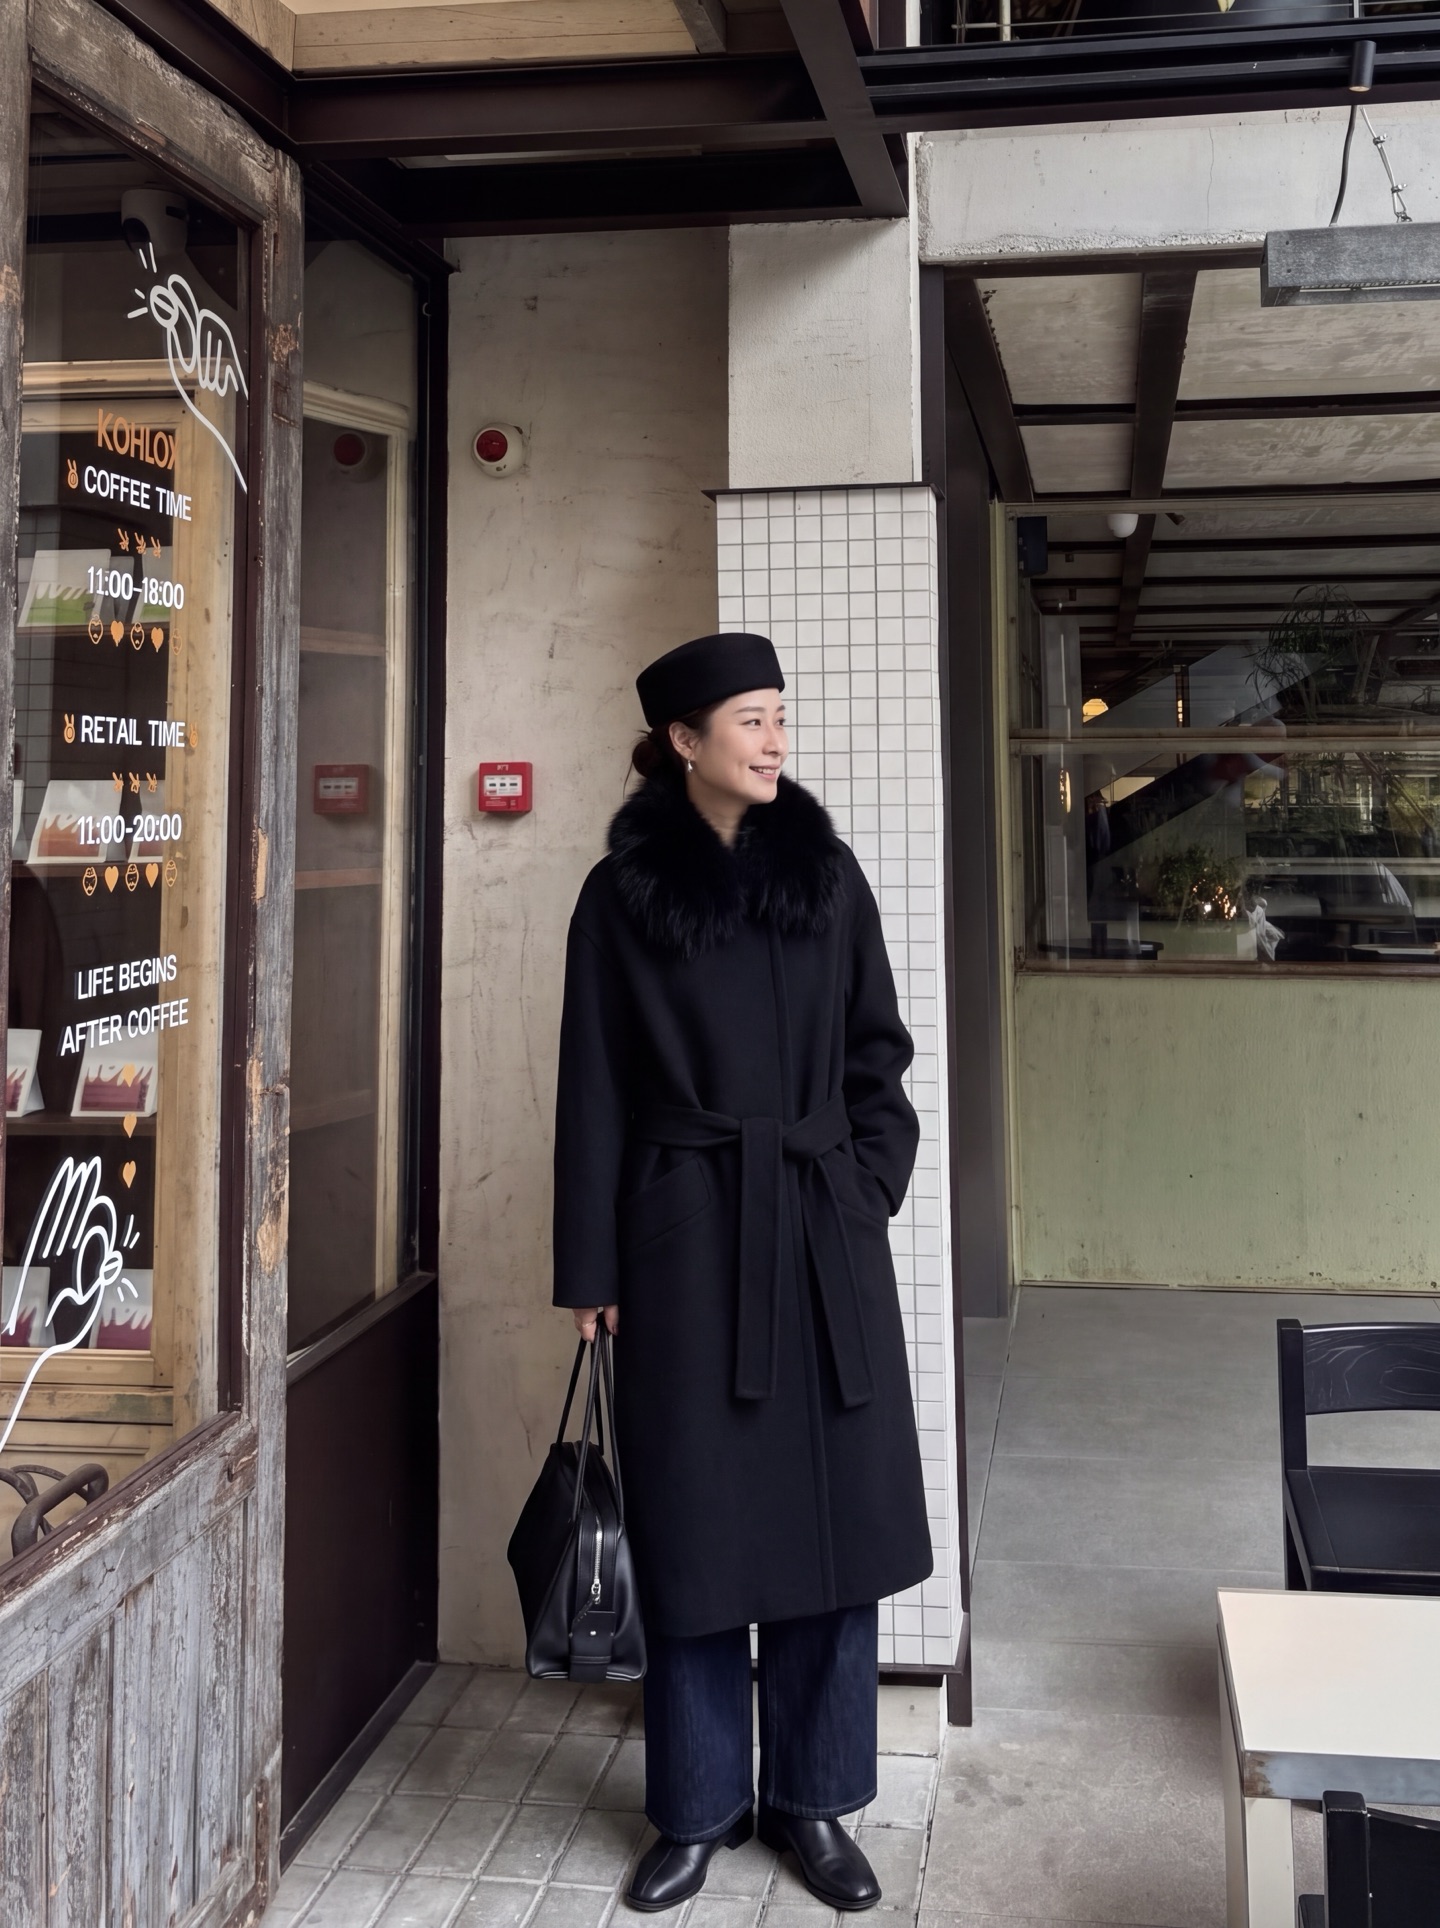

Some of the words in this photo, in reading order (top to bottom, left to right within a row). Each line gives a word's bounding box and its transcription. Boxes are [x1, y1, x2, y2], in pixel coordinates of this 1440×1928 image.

[84, 465, 151, 510] COFFEE
[155, 486, 192, 522] TIME
[88, 566, 185, 610] 11:00-18:00
[81, 715, 143, 746] RETAIL
[148, 720, 186, 748] TIME
[77, 814, 183, 845] 11:00-20:00
[78, 965, 114, 1000] LIFE
[118, 954, 177, 992] BEGINS
[60, 1014, 123, 1057] AFTER
[127, 998, 189, 1038] COFFEE
